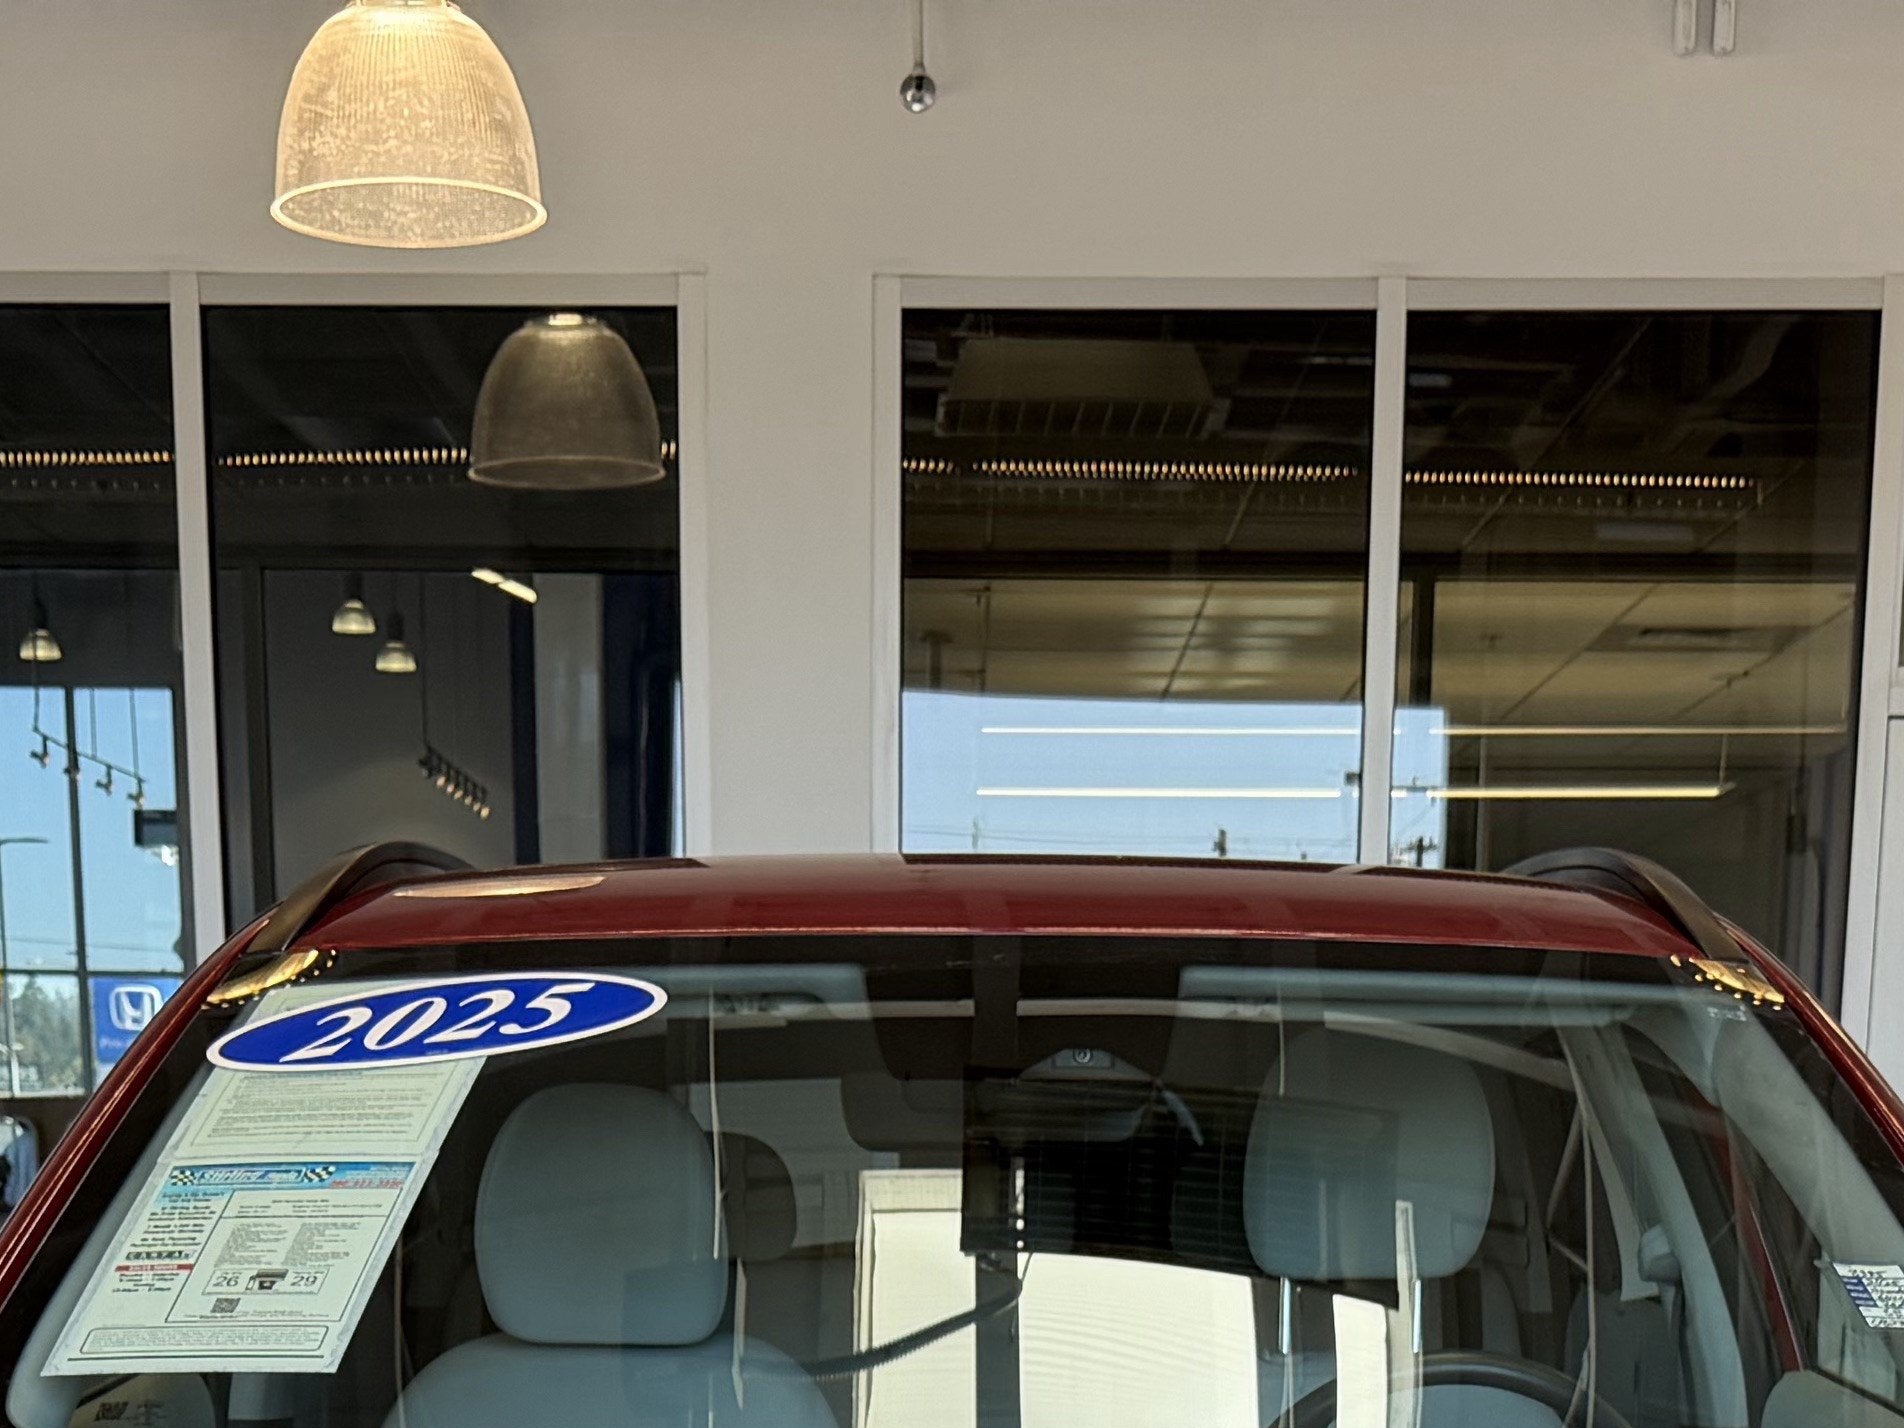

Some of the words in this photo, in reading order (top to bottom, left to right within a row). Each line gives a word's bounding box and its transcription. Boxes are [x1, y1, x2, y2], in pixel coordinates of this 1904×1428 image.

[279, 982, 595, 1062] 2025
[212, 1275, 240, 1288] 26
[290, 1275, 318, 1288] 29
